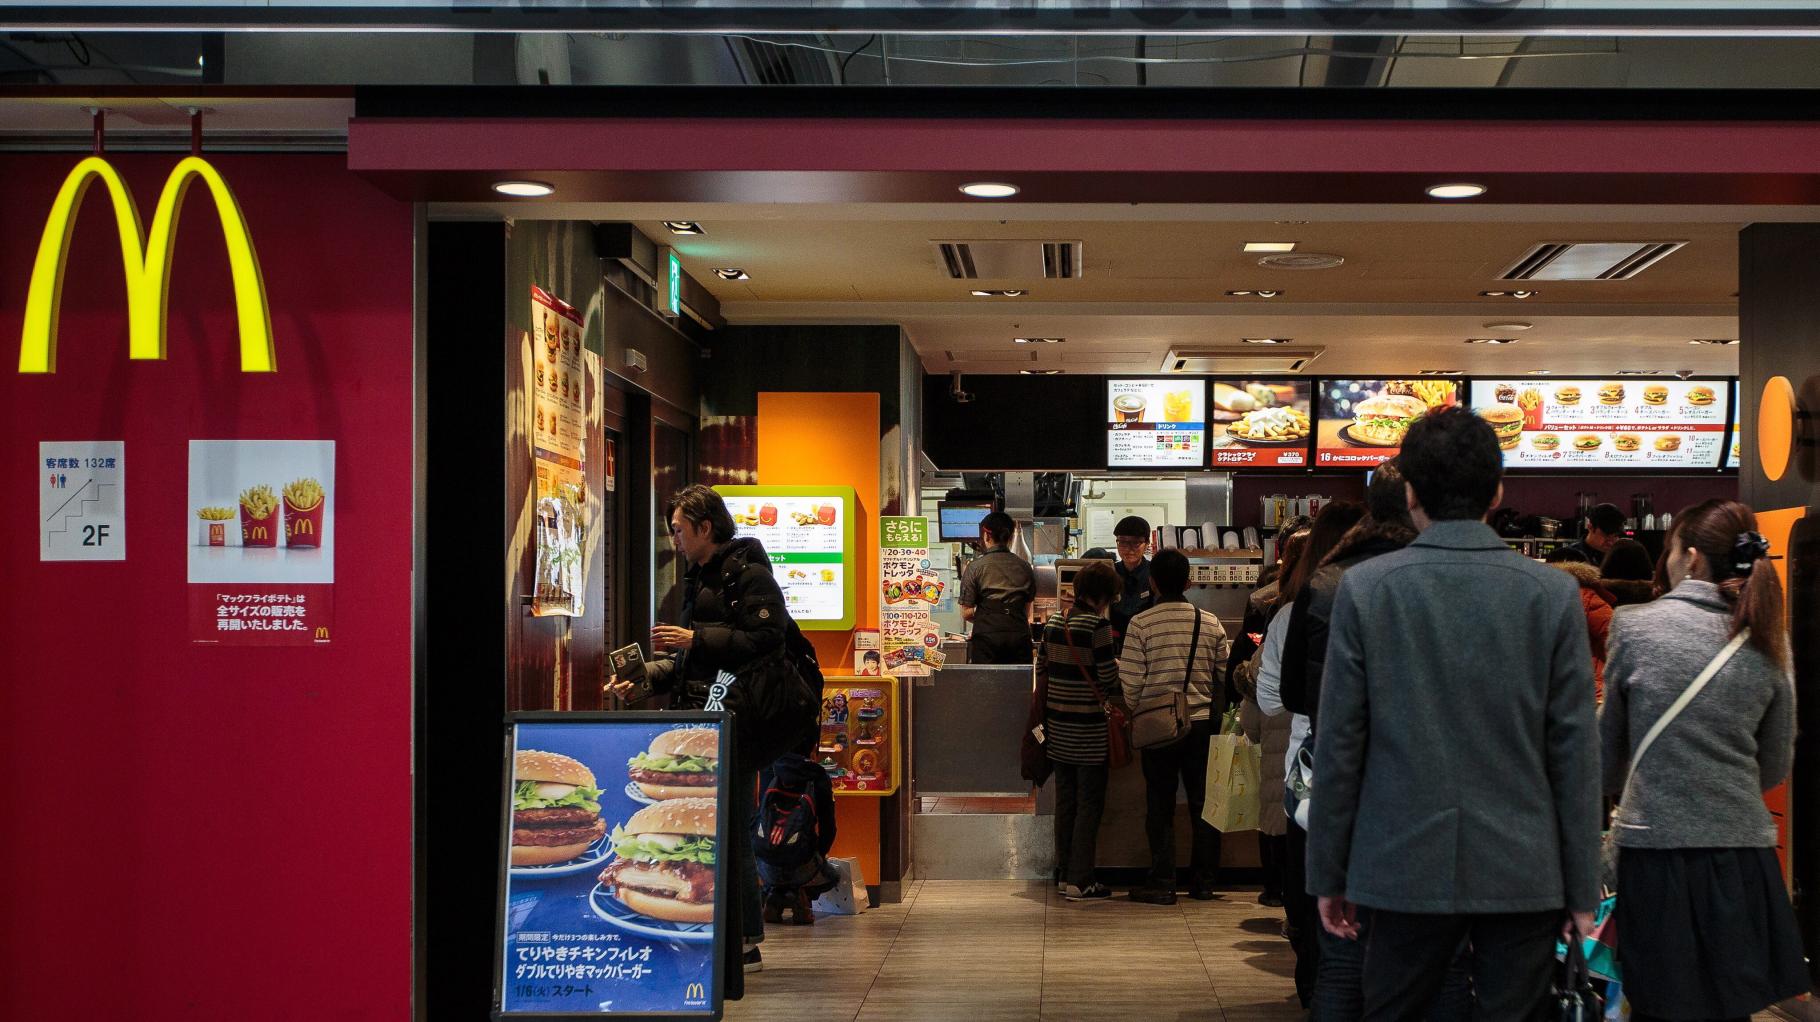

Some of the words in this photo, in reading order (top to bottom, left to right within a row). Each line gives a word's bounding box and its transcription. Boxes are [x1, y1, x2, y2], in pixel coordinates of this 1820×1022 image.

[1320, 452, 1330, 462] 16
[46, 458, 80, 469] 客席数
[85, 458, 116, 469] 132席
[886, 520, 922, 533] さらに
[82, 524, 110, 546] 2F
[886, 534, 922, 542] もらえる!
[883, 562, 915, 570] ポケモン
[883, 570, 914, 578] トレッタ
[216, 594, 306, 604] 「マックフライポテト」は
[216, 605, 306, 616] 全サイズの販売を
[216, 619, 308, 630] 再開いたしました。
[884, 620, 915, 628] ポケモン
[884, 628, 922, 636] スクラップ
[516, 946, 652, 961] てりやきチキンフィレオ
[516, 964, 652, 980] ダブルてりやきマックバーガー
